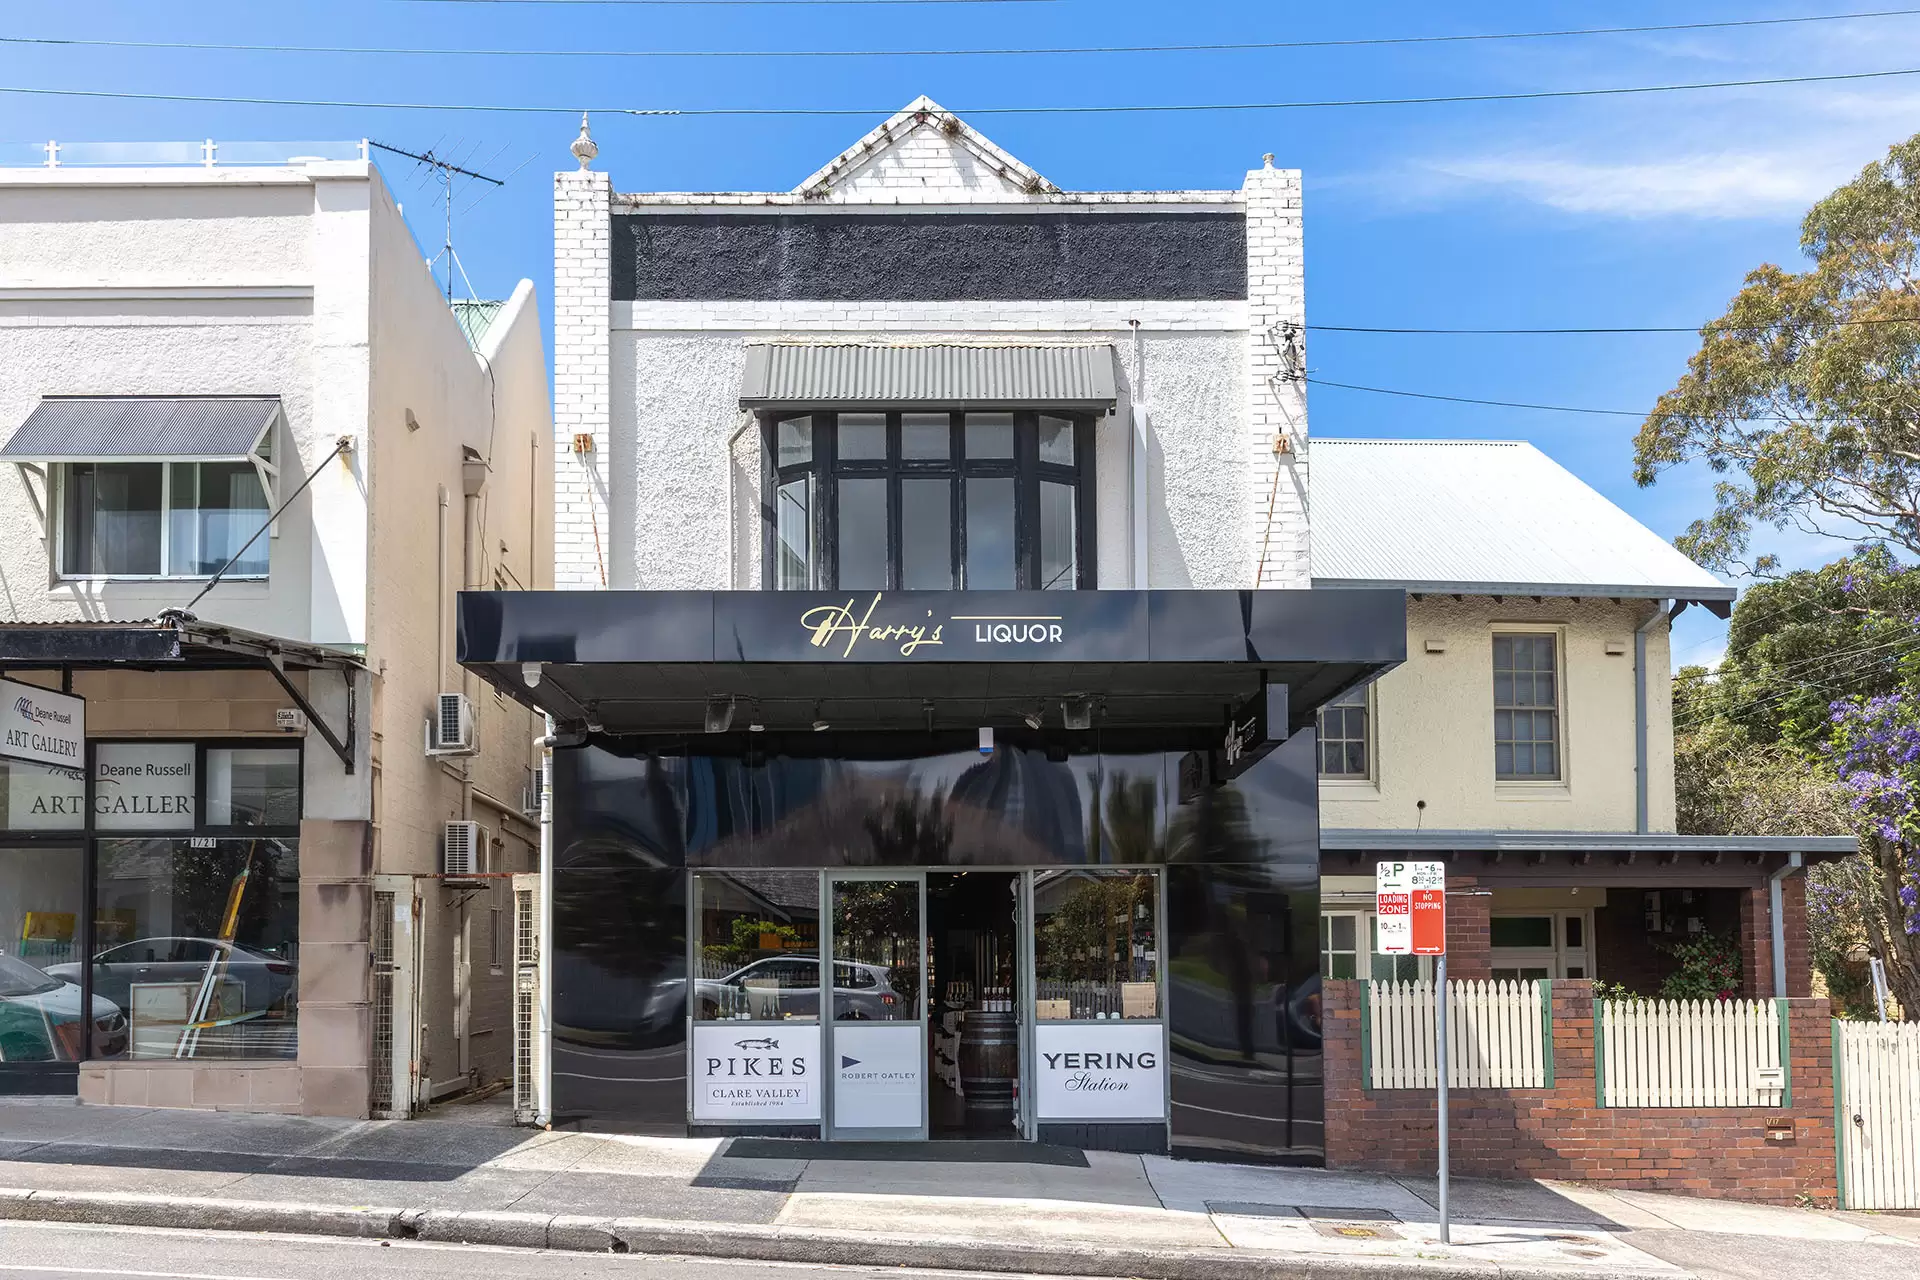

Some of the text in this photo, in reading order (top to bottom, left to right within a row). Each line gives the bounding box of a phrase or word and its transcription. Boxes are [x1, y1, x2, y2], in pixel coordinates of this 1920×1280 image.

[801, 592, 1063, 658] Harry's LIQUOR
[35, 707, 72, 724] Deane Russell
[6, 728, 78, 757] ART GALLERY
[100, 763, 191, 776] Deane Russell
[31, 795, 195, 814] ART GALLER
[193, 838, 215, 848] 1/21
[1393, 863, 1404, 877] P
[1380, 894, 1408, 904] LOADING
[1415, 902, 1441, 910] STOPPING
[1380, 905, 1408, 914] ZONE
[707, 1057, 806, 1076] PIKES
[1042, 1052, 1156, 1069] YERING
[1064, 1071, 1129, 1091] Station
[712, 1089, 801, 1098] CLARE VALLEY
